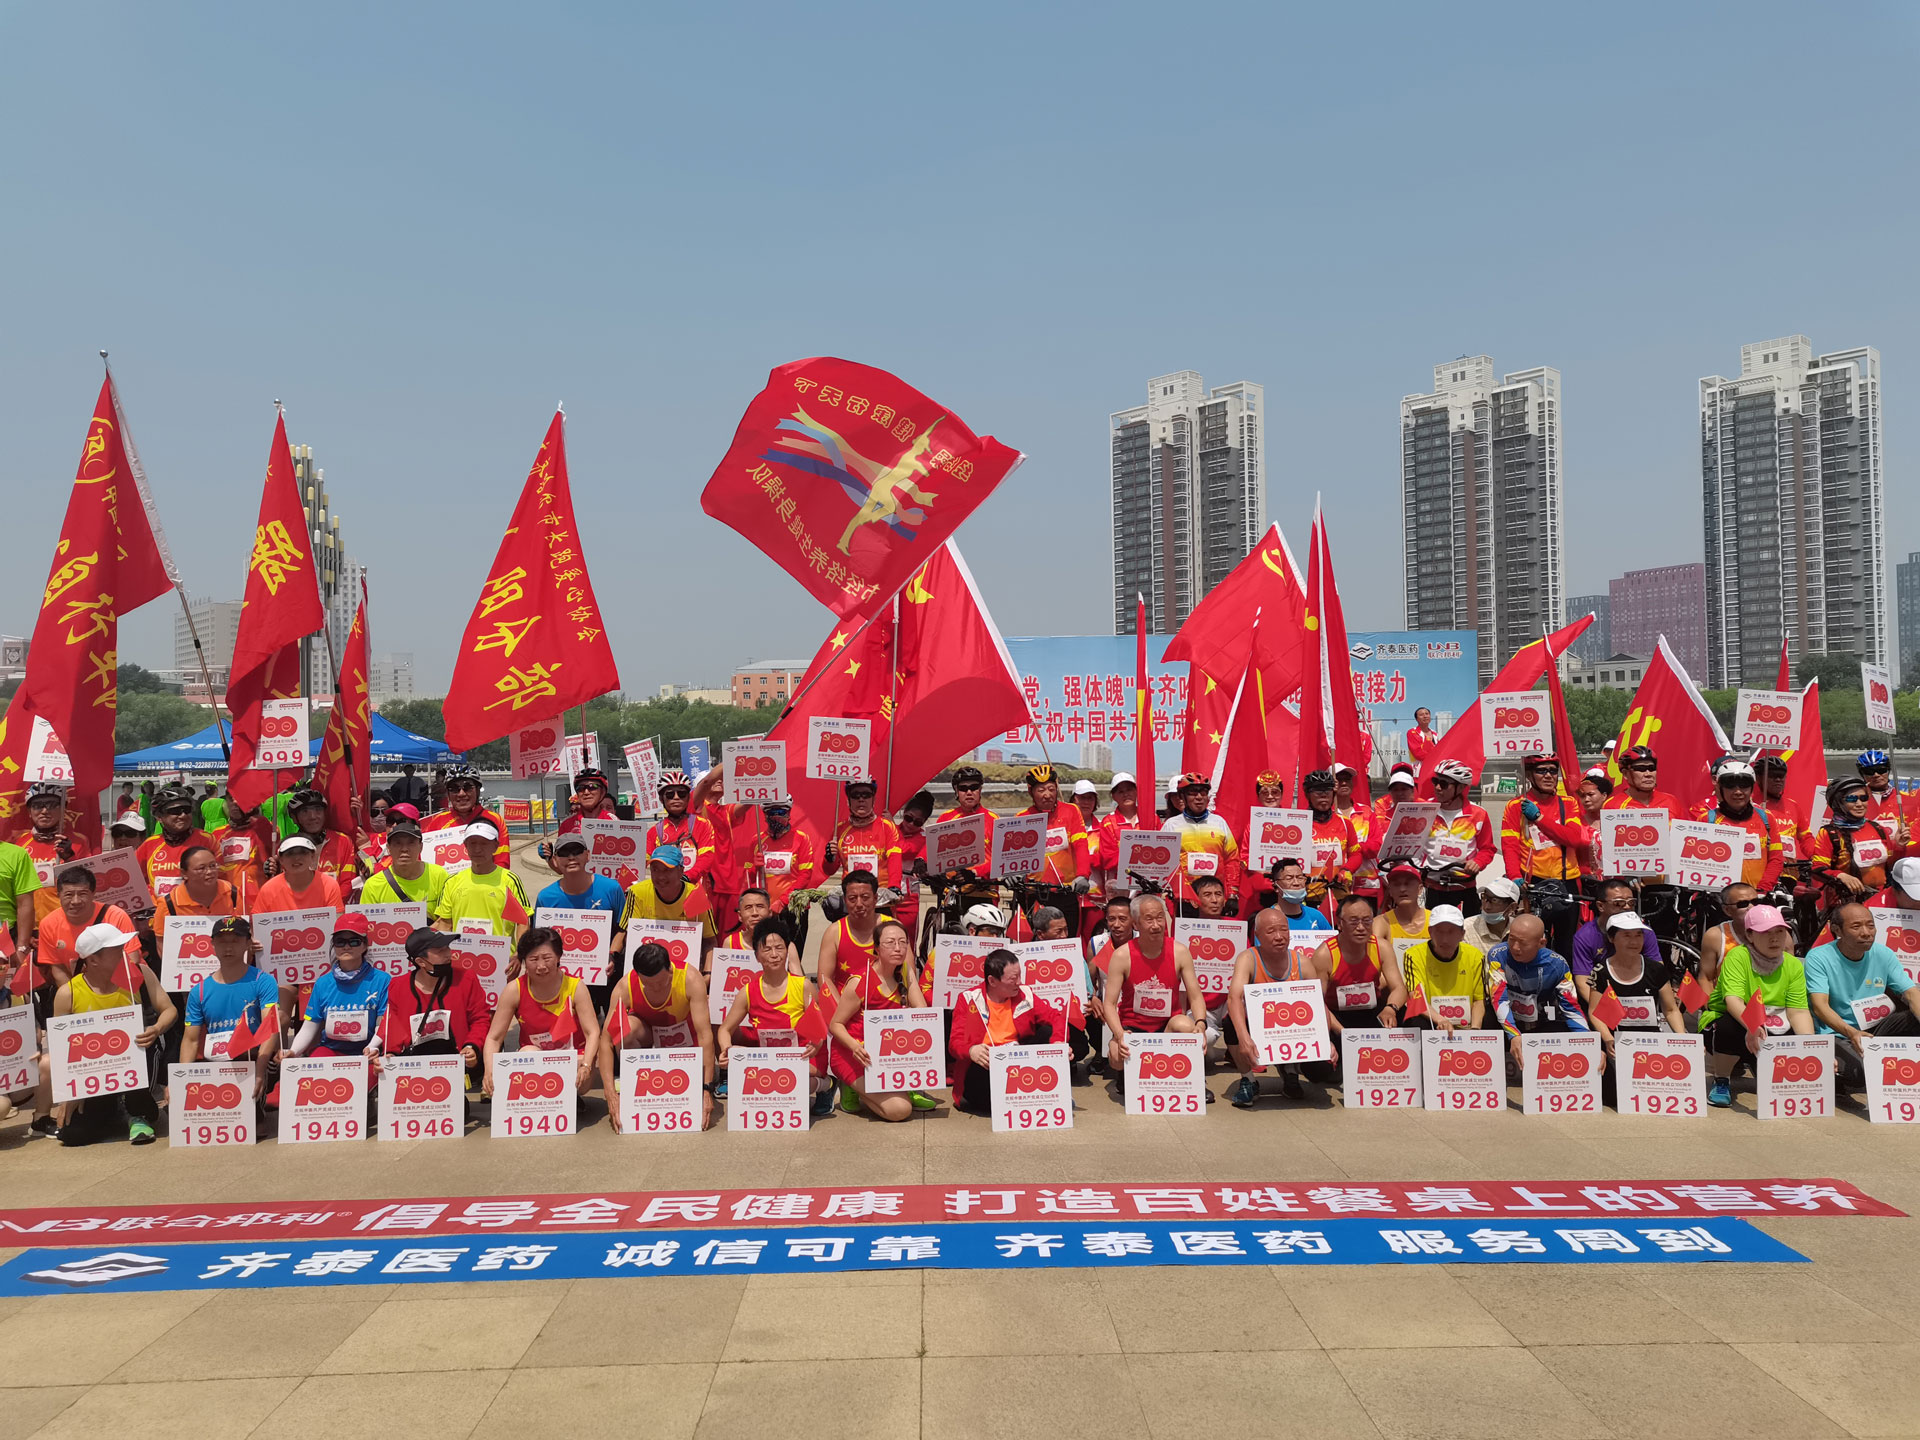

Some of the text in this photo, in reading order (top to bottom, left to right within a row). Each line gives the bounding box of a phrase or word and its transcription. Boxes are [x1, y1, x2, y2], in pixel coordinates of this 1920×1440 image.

[1377, 644, 1419, 654] 齐泰医药
[1870, 680, 1888, 704] 100
[1494, 707, 1540, 729] 100
[1748, 703, 1791, 724] 100
[1872, 714, 1894, 729] 1974
[520, 727, 556, 752] 100
[819, 731, 861, 753] 100
[1493, 739, 1544, 754] 1976
[1742, 733, 1792, 747] 2004
[519, 758, 560, 779] 1992
[735, 756, 777, 777] 100
[816, 764, 861, 778] 1982
[732, 787, 778, 802] 1981
[1261, 822, 1302, 845] 100
[1399, 816, 1429, 835] 100
[1614, 825, 1659, 848] 100
[592, 834, 636, 855] 100
[937, 830, 976, 852] 100
[1002, 830, 1038, 852] 100
[1680, 836, 1732, 863] 100
[936, 854, 980, 872] 1998
[1000, 859, 1039, 871] 1980
[1128, 844, 1171, 865] 100
[1613, 859, 1665, 874] 1975
[1677, 870, 1732, 887] 1973
[271, 927, 325, 954] 100
[1189, 936, 1235, 961] 100
[270, 963, 331, 985] 1952
[374, 958, 416, 976] 955
[1025, 958, 1074, 985] 100
[176, 973, 203, 989] 19
[1197, 973, 1231, 990] 933
[1262, 1001, 1314, 1029] 100
[68, 1030, 130, 1064] 100
[880, 1028, 933, 1056] 100
[1265, 1041, 1320, 1062] 1921
[1139, 1052, 1192, 1079] 100
[1357, 1047, 1410, 1074] 100
[1438, 1049, 1492, 1076] 100
[1537, 1052, 1589, 1080] 100
[1632, 1051, 1691, 1080] 100
[1772, 1056, 1823, 1083] 100
[66, 1070, 138, 1097] 1953
[394, 1076, 451, 1104] 100
[507, 1072, 564, 1101] 100
[634, 1068, 690, 1097] 100
[742, 1067, 797, 1095] 100
[878, 1069, 938, 1089] 1938
[1005, 1065, 1058, 1094] 100
[184, 1082, 242, 1111] 100
[296, 1077, 354, 1106] 100
[1356, 1088, 1416, 1107] 1927
[1437, 1091, 1499, 1109] 1928
[1137, 1095, 1199, 1112] 1925
[1536, 1094, 1594, 1112] 1922
[1630, 1096, 1697, 1114] 1923
[1770, 1097, 1824, 1117] 1931
[392, 1118, 454, 1138] 1946
[504, 1114, 568, 1135] 1940
[632, 1111, 692, 1131] 1936
[740, 1111, 802, 1129] 1935
[1004, 1108, 1066, 1128] 1929
[182, 1125, 247, 1144] 1950
[292, 1120, 359, 1141] 1949
[353, 1192, 905, 1231] 倡导全民健康
[943, 1182, 1863, 1220] 打造百姓餐桌上的营养
[0, 1218, 109, 1232] NB
[602, 1235, 943, 1267] 诚信可靠
[995, 1231, 1333, 1259] 齐泰医药
[1378, 1226, 1733, 1255] 服务周到
[197, 1245, 560, 1280] 齐泰医药
